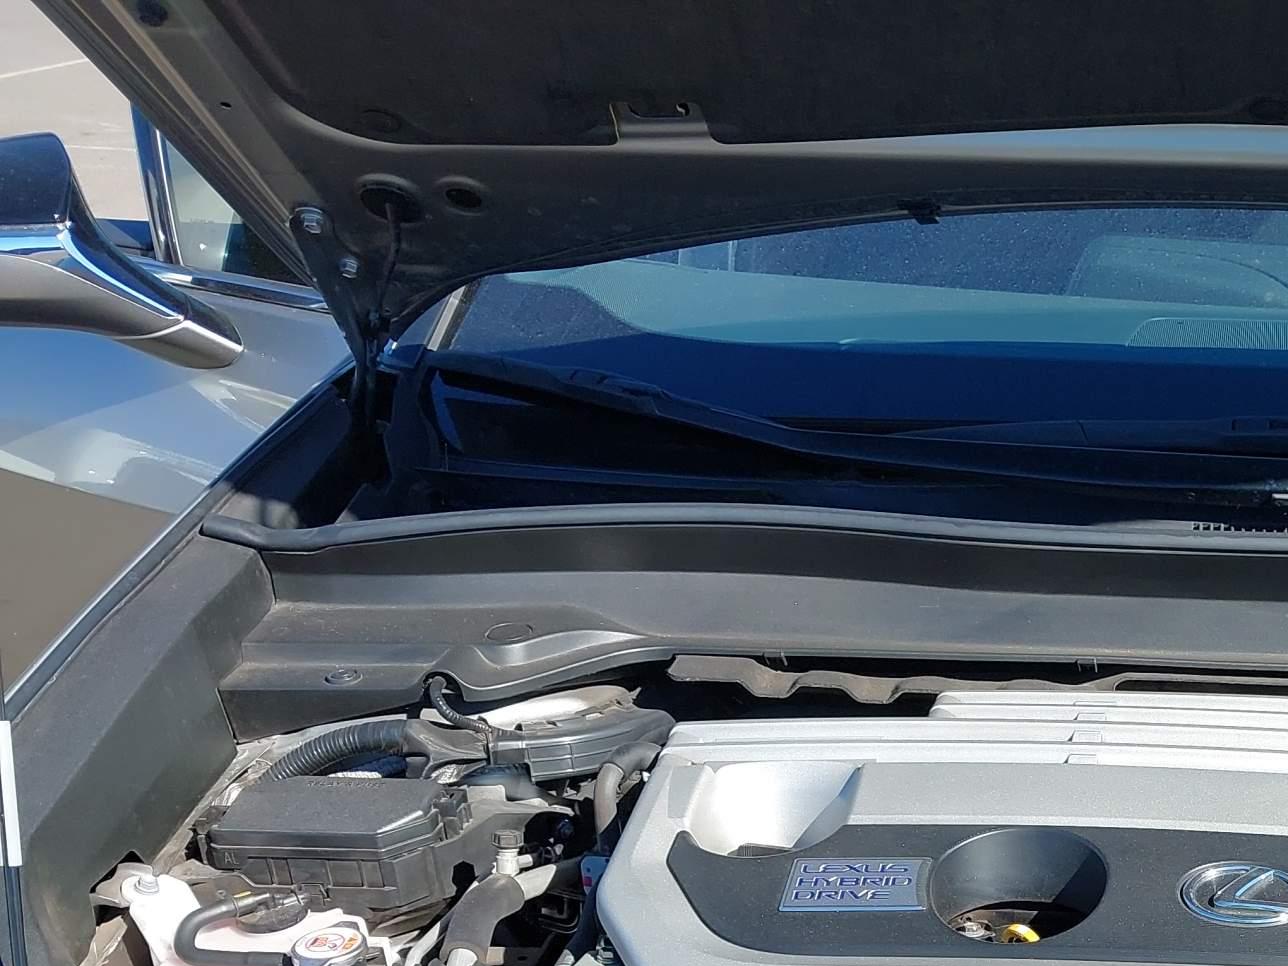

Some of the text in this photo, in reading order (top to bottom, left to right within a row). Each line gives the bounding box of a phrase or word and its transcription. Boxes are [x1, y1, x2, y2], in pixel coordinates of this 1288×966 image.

[800, 863, 909, 874] LEXUS
[795, 876, 913, 887] HYBRID
[791, 889, 891, 901] DRIVE
